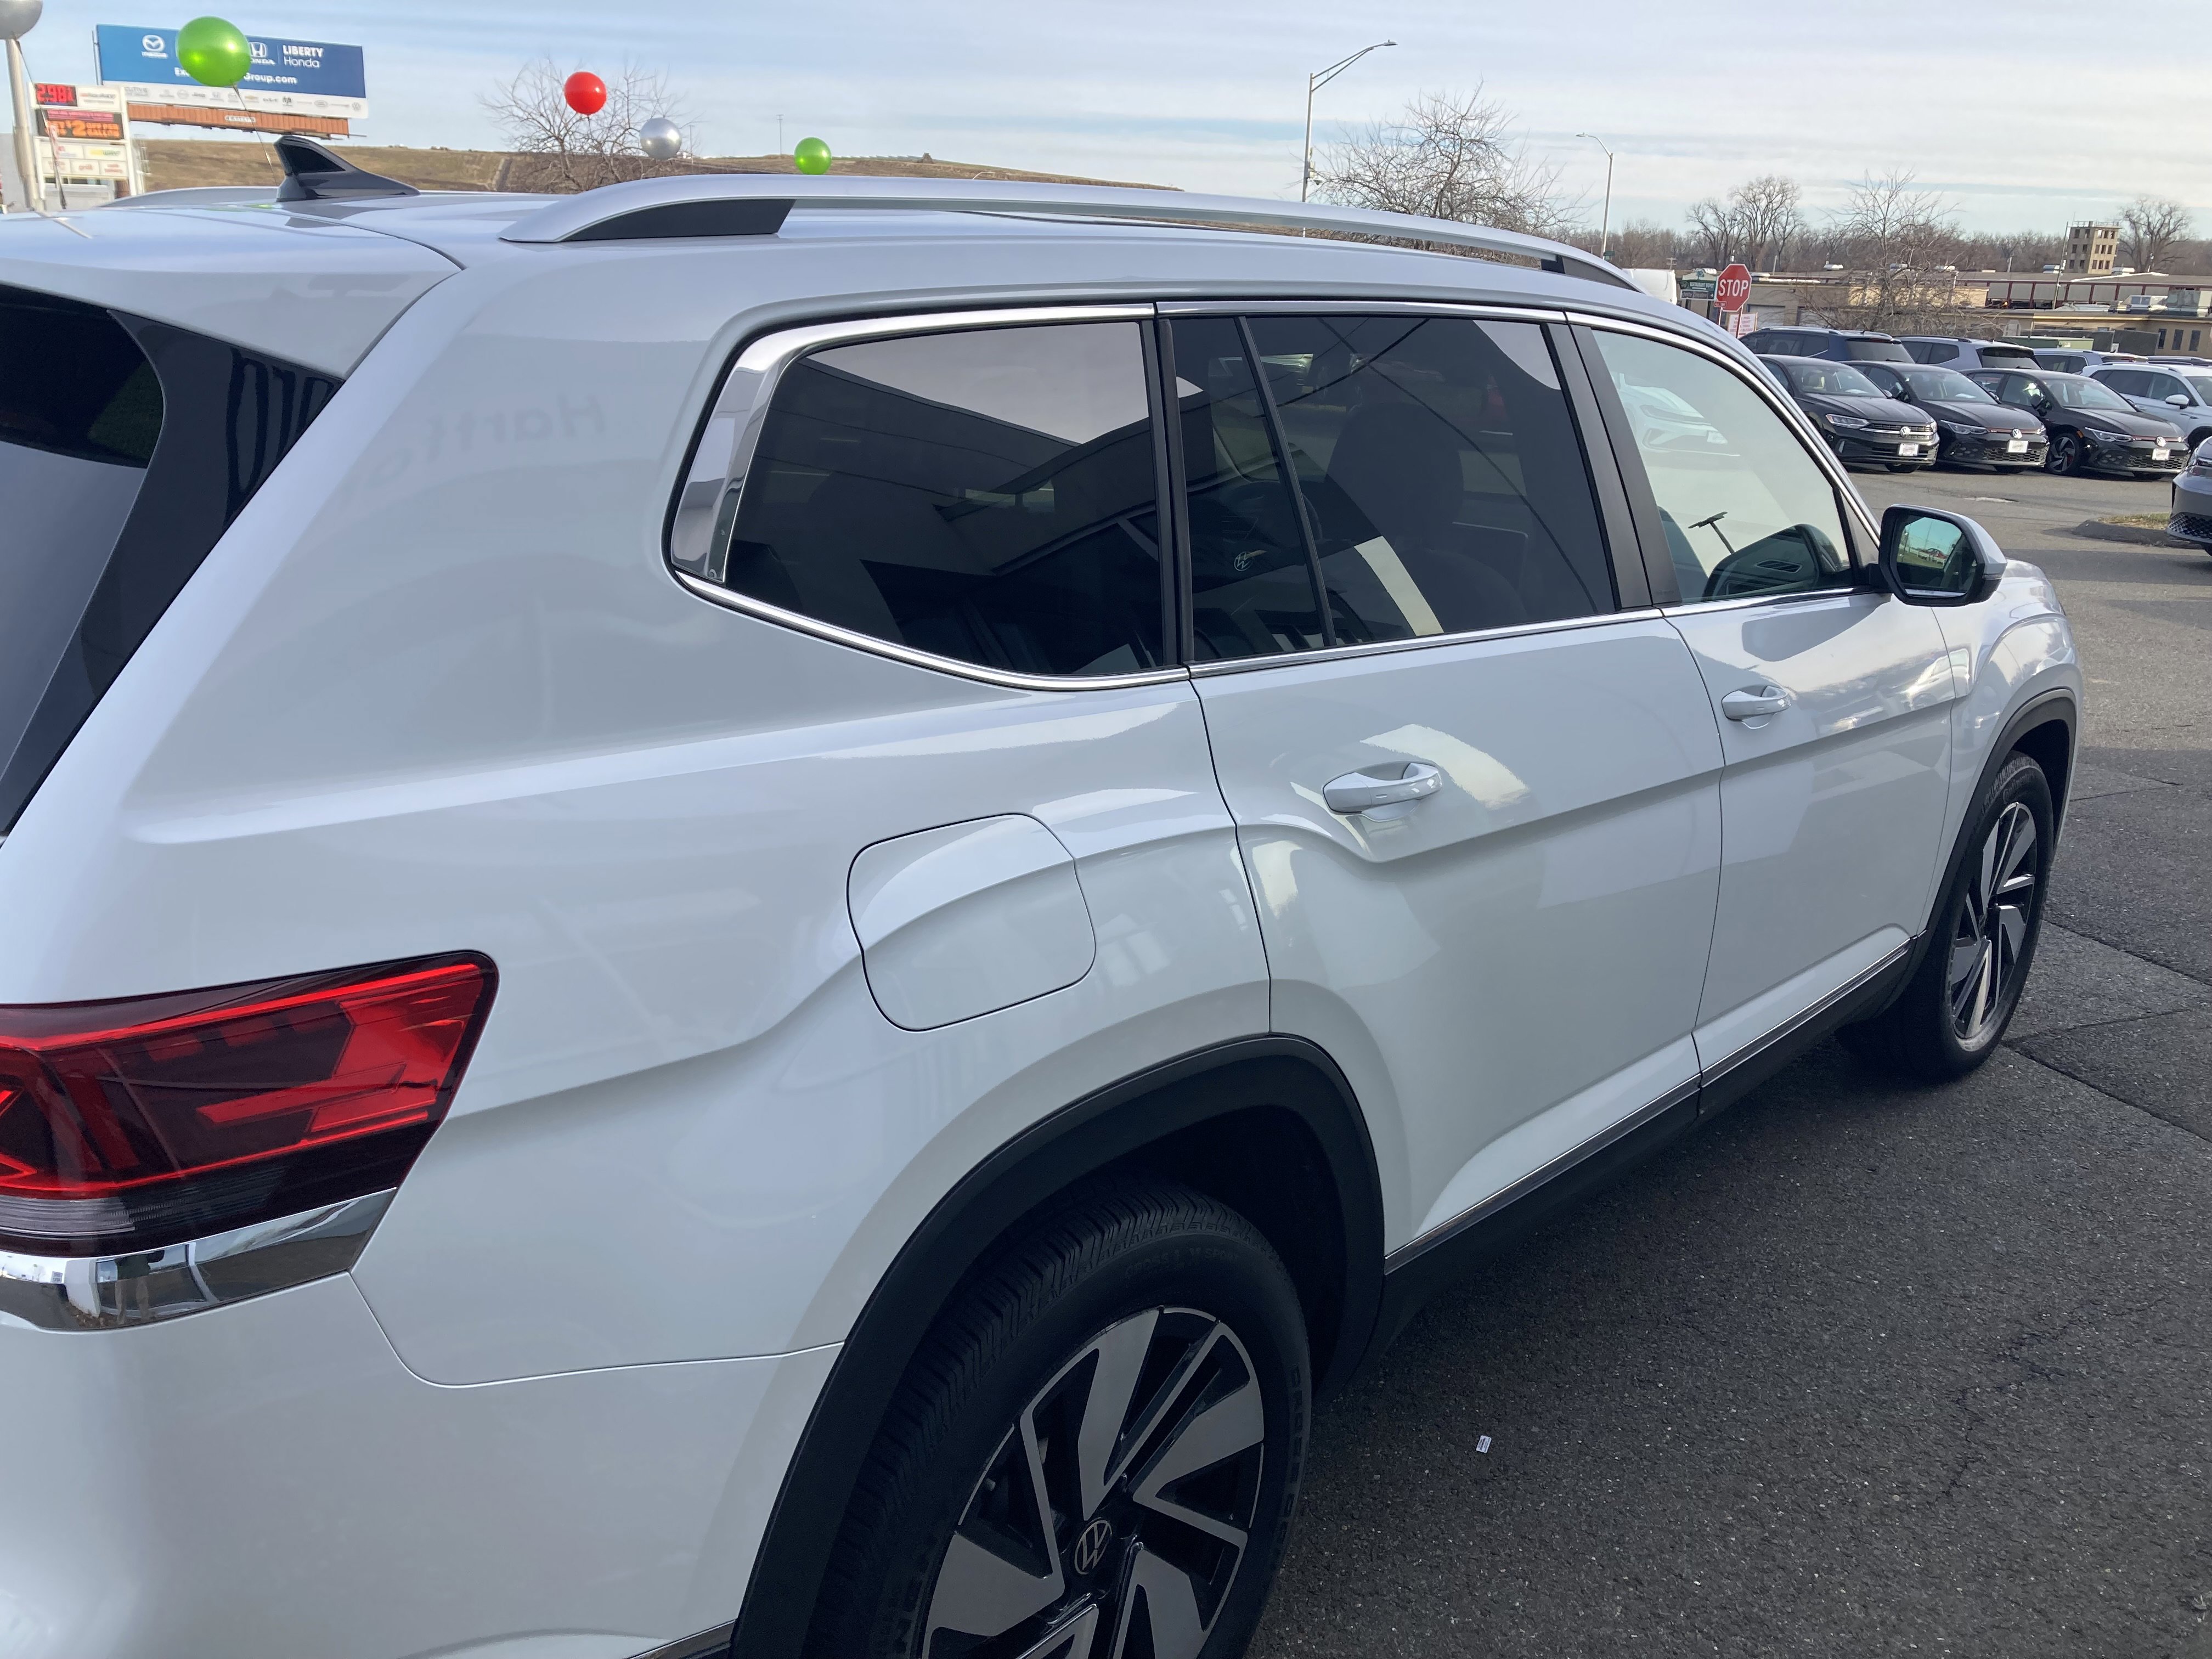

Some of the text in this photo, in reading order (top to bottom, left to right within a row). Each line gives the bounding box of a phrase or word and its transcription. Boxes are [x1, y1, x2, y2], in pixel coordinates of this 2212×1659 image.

[283, 44, 324, 58] LIBERTY
[284, 56, 320, 68] Honda
[1718, 279, 1749, 297] STOP
